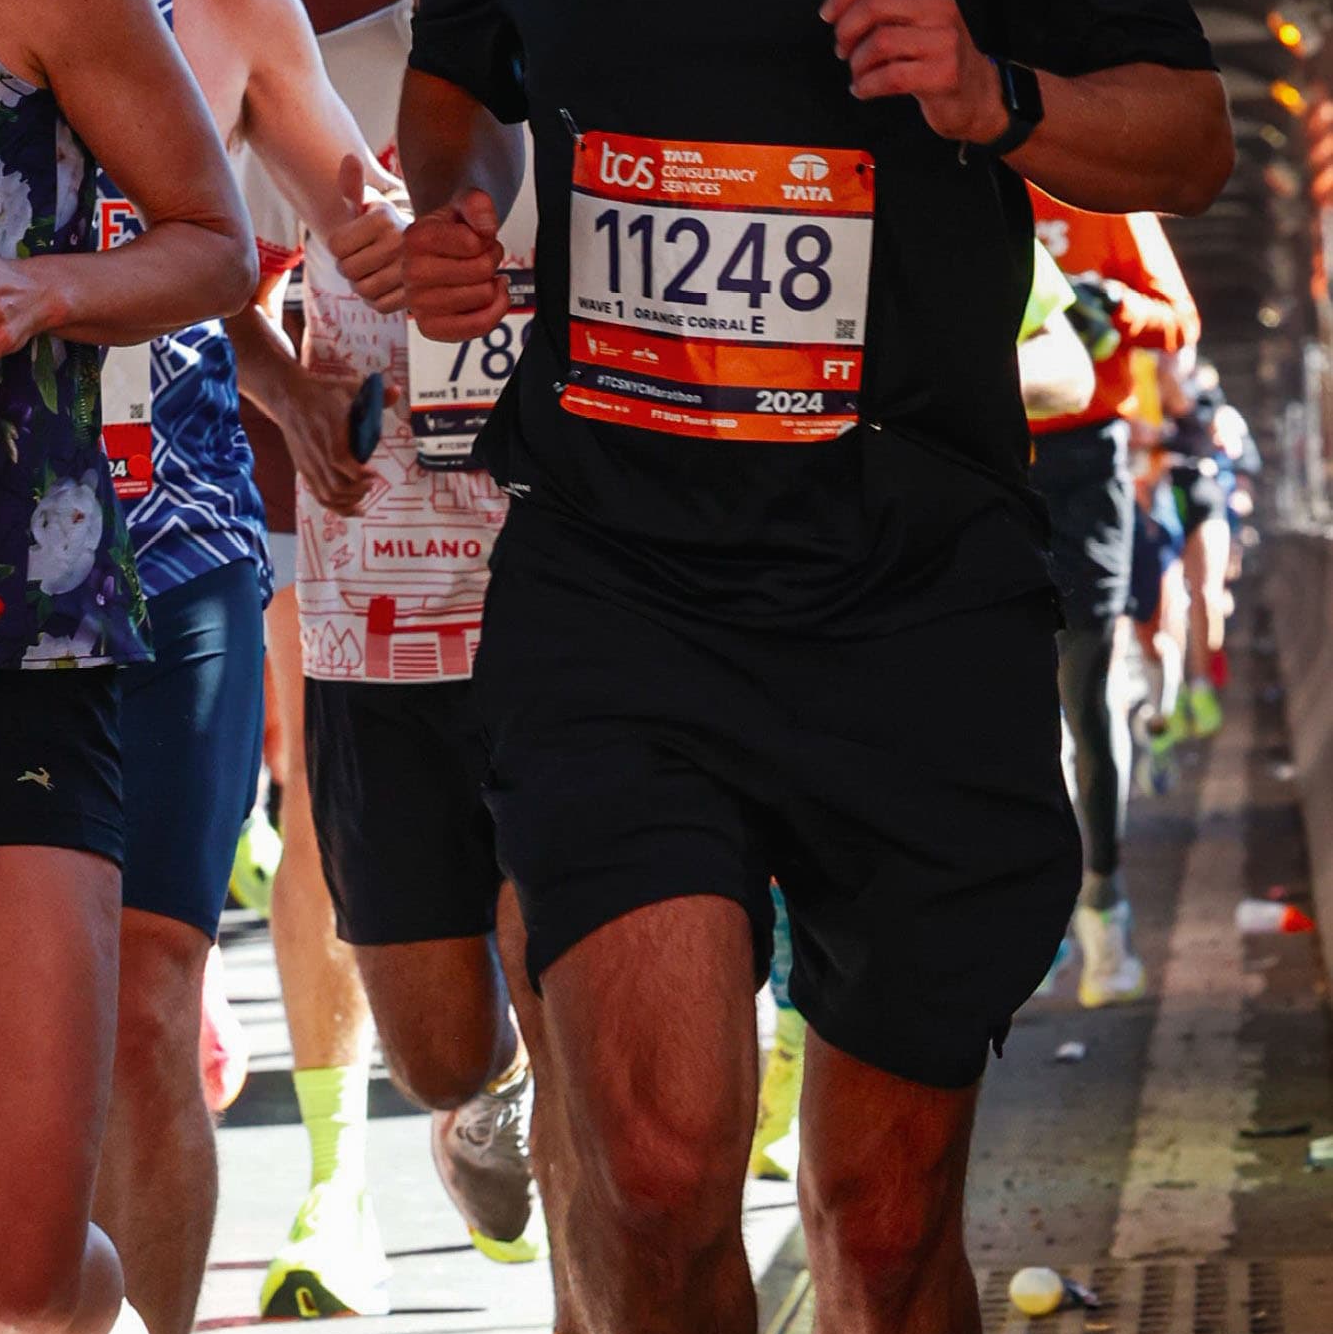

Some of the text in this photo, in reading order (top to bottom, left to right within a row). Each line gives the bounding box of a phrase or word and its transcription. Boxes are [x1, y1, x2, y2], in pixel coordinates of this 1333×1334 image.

[662, 149, 704, 164] TATA
[661, 166, 757, 183] CONSULTANCY
[661, 182, 722, 196] SERVICES
[780, 184, 834, 202] TATA
[595, 208, 833, 313] 11248
[577, 295, 765, 334] WAVE 1 ORANGE CORRAL E
[823, 360, 855, 380] FT
[755, 389, 825, 414] 2024
[373, 539, 482, 558] MILANO
